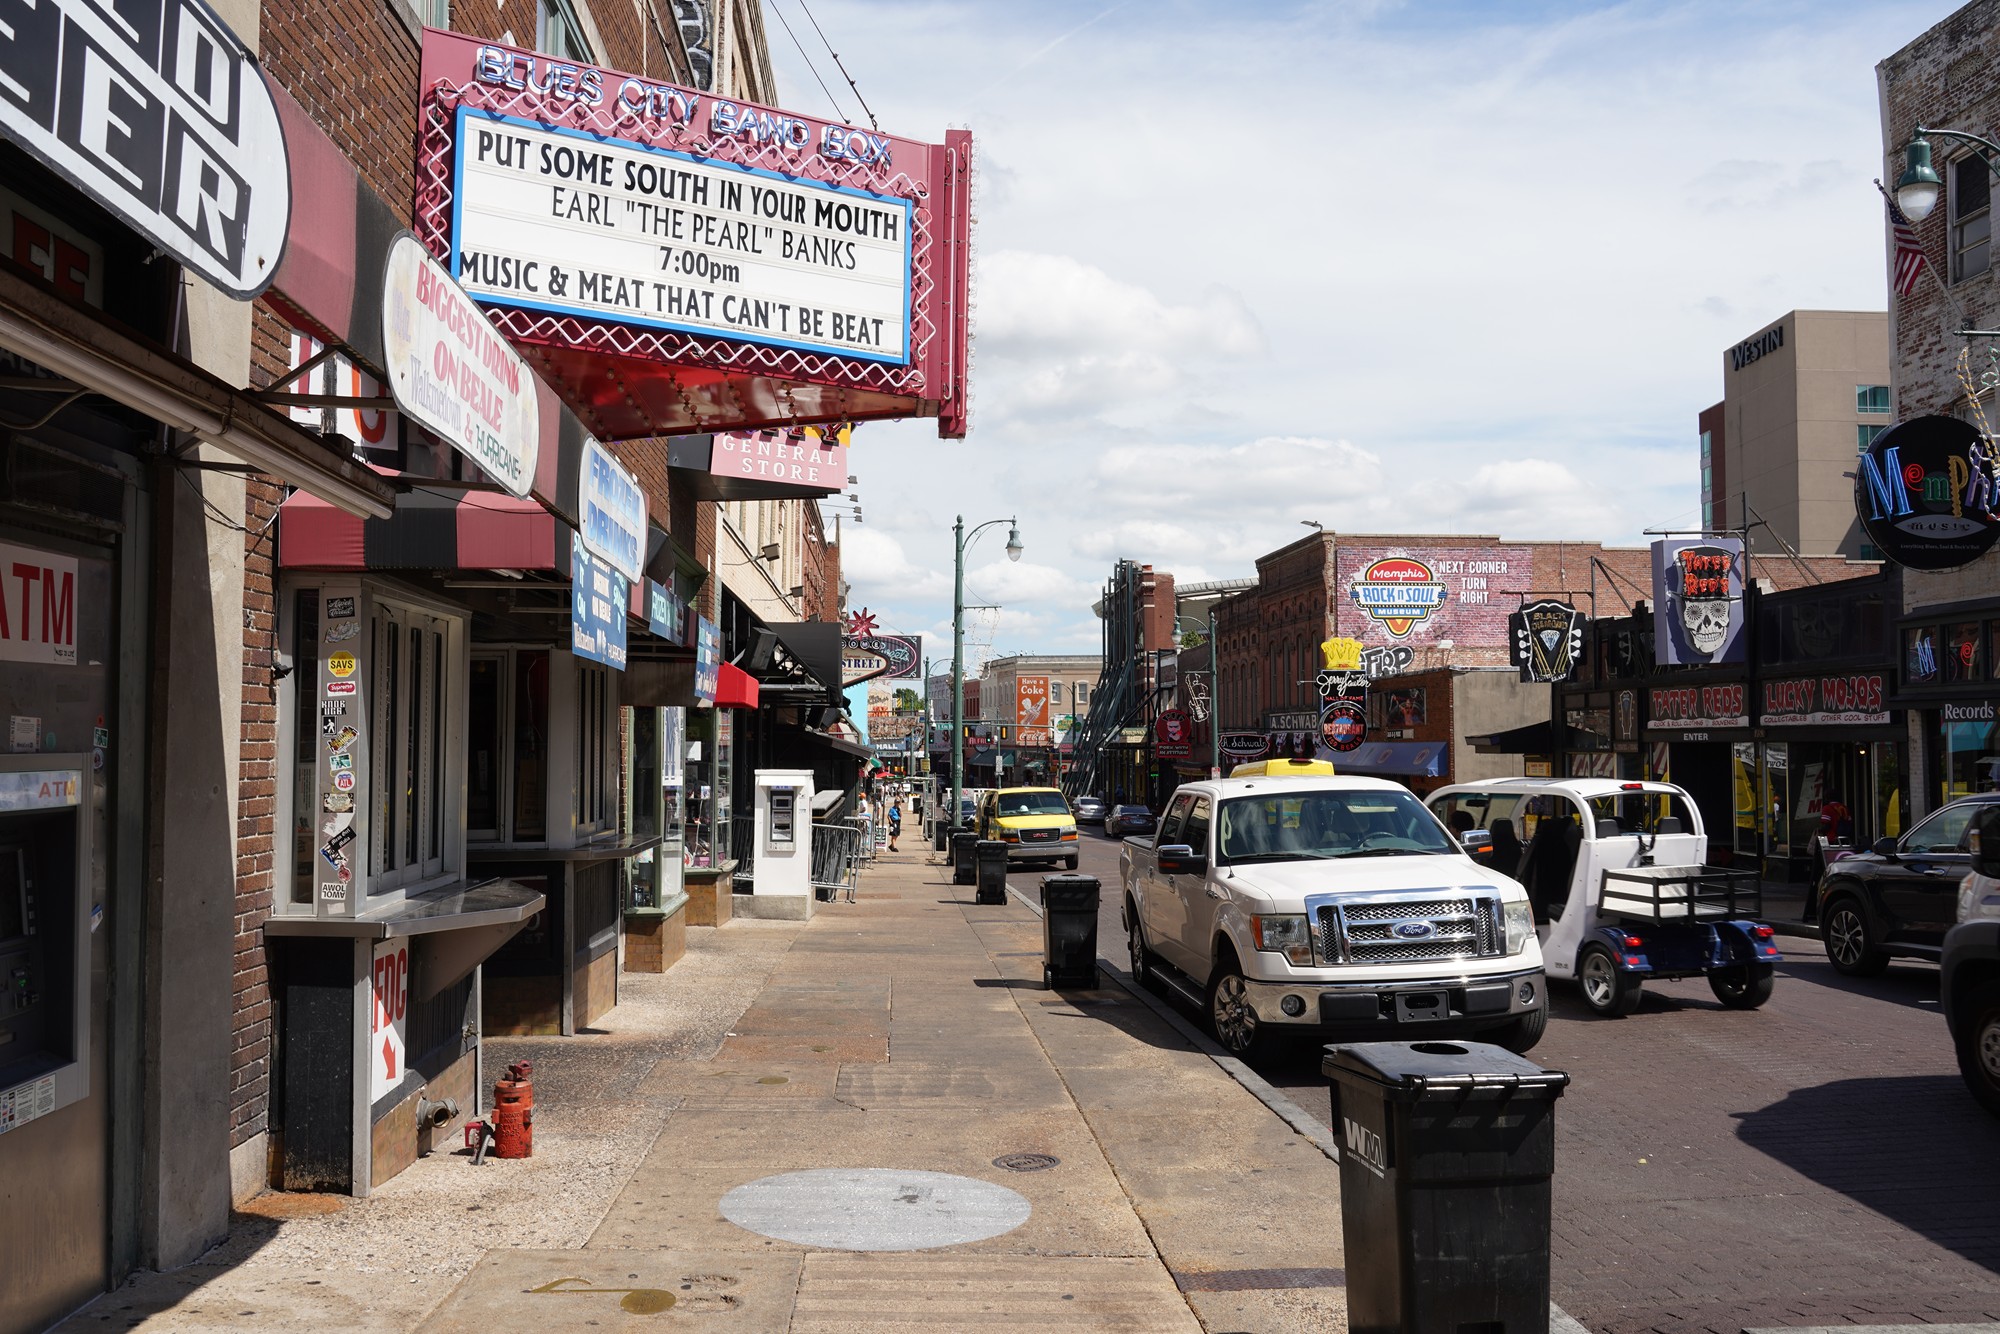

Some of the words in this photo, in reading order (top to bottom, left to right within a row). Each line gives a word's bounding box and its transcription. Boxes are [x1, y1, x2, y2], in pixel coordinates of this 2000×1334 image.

[477, 44, 604, 107] BLUES
[618, 77, 701, 125] CITY
[711, 99, 811, 150] BAND
[821, 124, 892, 170] BOX
[478, 130, 530, 169] PUT
[540, 144, 614, 187] SOME
[624, 160, 709, 206] SOUTH
[720, 180, 742, 212] IN
[751, 186, 806, 224] YOUR
[814, 198, 898, 241] MOUTH
[552, 186, 615, 228] EARL
[626, 200, 684, 240] "THE
[692, 213, 773, 254] PEARL"
[782, 229, 856, 270] BANKS
[660, 246, 740, 283] 7:00pm
[460, 251, 538, 292] MUSIC
[548, 266, 569, 297] &
[579, 270, 644, 309] MEAT
[653, 283, 714, 319] THAT
[722, 295, 790, 332] CAN'T
[799, 307, 824, 338] BE
[832, 312, 884, 346] BEAT
[416, 260, 483, 359] BIGGEST
[482, 328, 521, 398] DRINK
[1731, 326, 1783, 371] WESTIN
[434, 340, 458, 394] ON
[460, 358, 503, 433] BEALE
[464, 413, 473, 444] &
[722, 435, 838, 466] GENERAL
[742, 458, 819, 482] STORE
[589, 447, 640, 529] FROZEN
[587, 499, 639, 573] DRINKS
[1439, 561, 1464, 574] NEXT
[1469, 561, 1508, 574] CORNER
[1681, 549, 1731, 573] TATER
[1372, 568, 1426, 581] Memphis
[1461, 577, 1487, 590] TURN
[1684, 573, 1730, 597] RED'S
[0, 562, 74, 645] TM
[1363, 587, 1396, 603] ROCK
[1405, 586, 1435, 603] SOUL
[1460, 591, 1489, 604] RIGHT
[1377, 608, 1421, 616] MUSEUM
[330, 661, 353, 669] SAVS
[842, 659, 881, 669] STREET
[1021, 685, 1044, 695] Coke
[1652, 688, 1698, 718] TATER
[1703, 684, 1743, 718] RED'S
[1766, 679, 1816, 713] LUCKY
[1821, 676, 1882, 713] MOJOS
[1844, 714, 1861, 722] COOL
[1864, 713, 1886, 721] STUFF
[1944, 701, 1994, 720] Records
[1324, 723, 1365, 735] RESTAURANT
[1683, 733, 1709, 741] ENTER
[38, 782, 75, 799] ATM
[1807, 767, 1825, 814] ATM
[322, 884, 345, 892] AWOL
[1405, 925, 1425, 934] Ford
[373, 948, 407, 1034] FDC
[1344, 1116, 1385, 1170] WM
